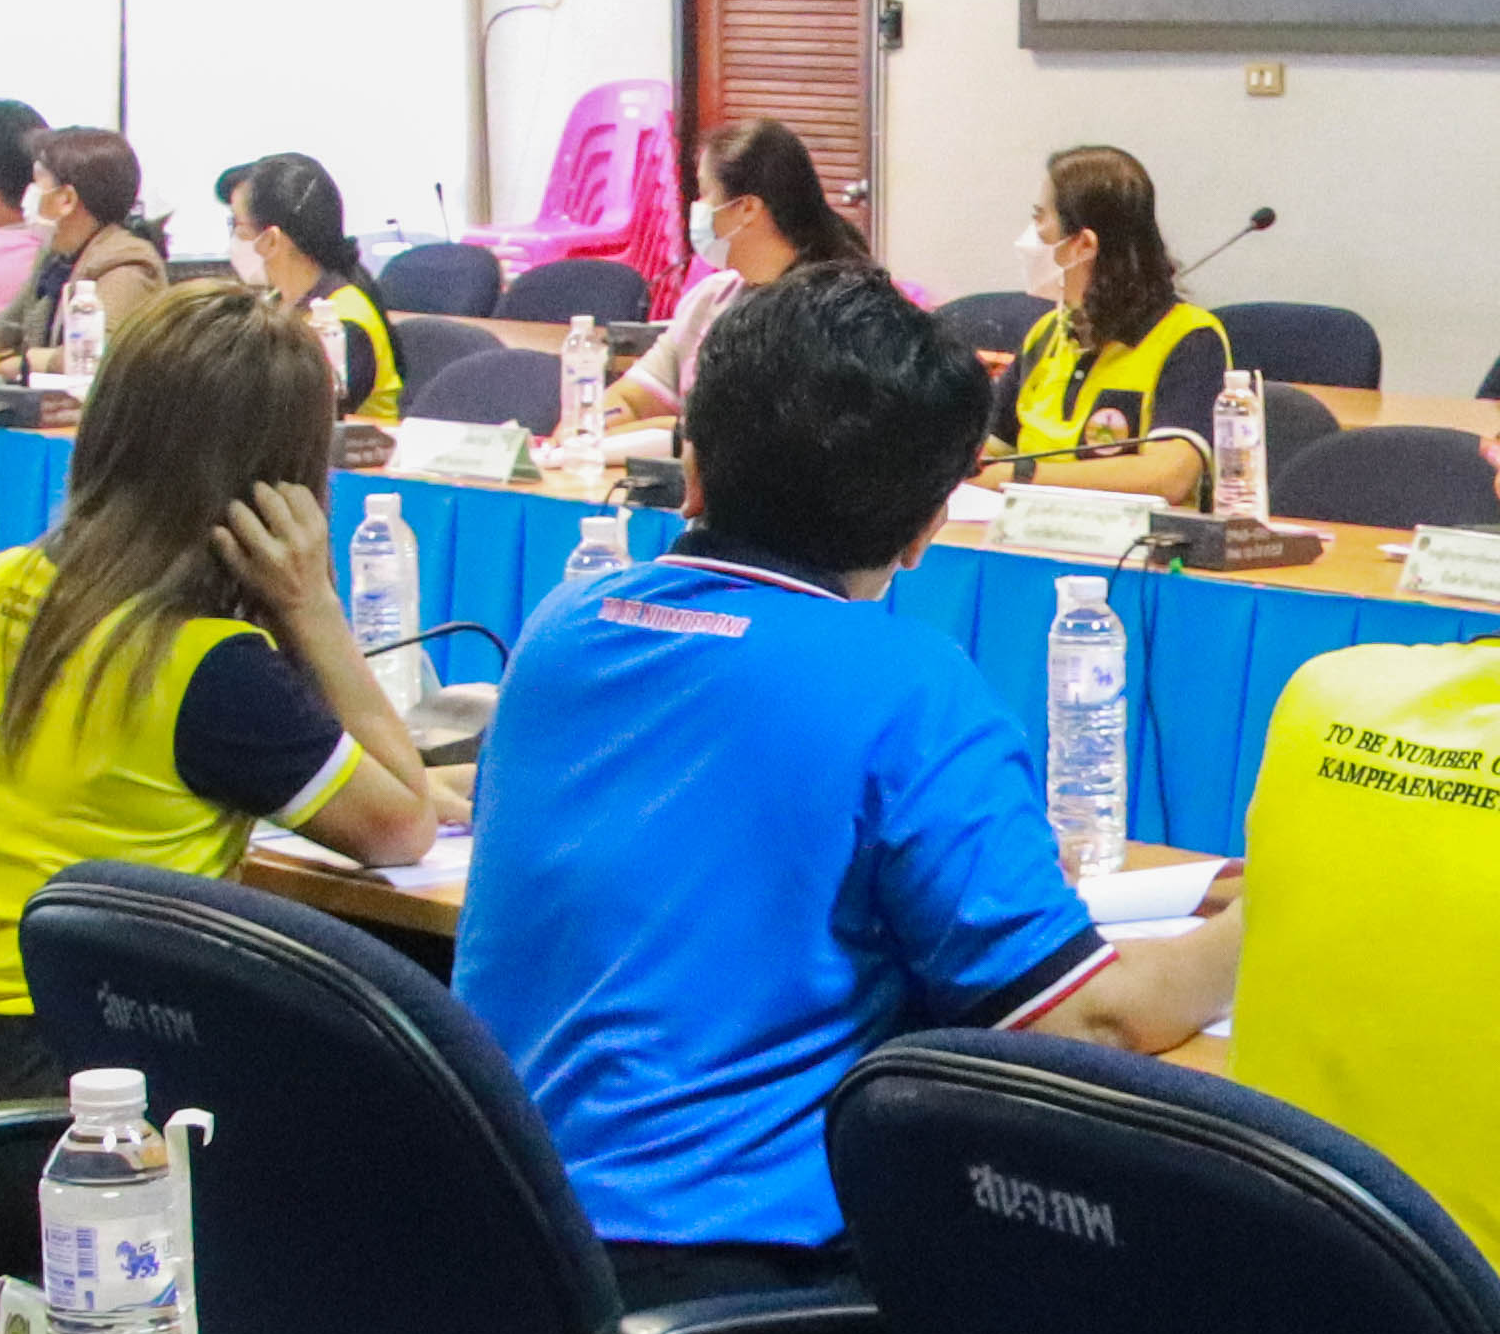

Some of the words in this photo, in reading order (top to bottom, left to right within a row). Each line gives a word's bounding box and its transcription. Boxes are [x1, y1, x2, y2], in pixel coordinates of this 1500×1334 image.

[1324, 723, 1354, 746] TO
[1354, 728, 1389, 754] BE
[1388, 739, 1484, 771] NUMBER
